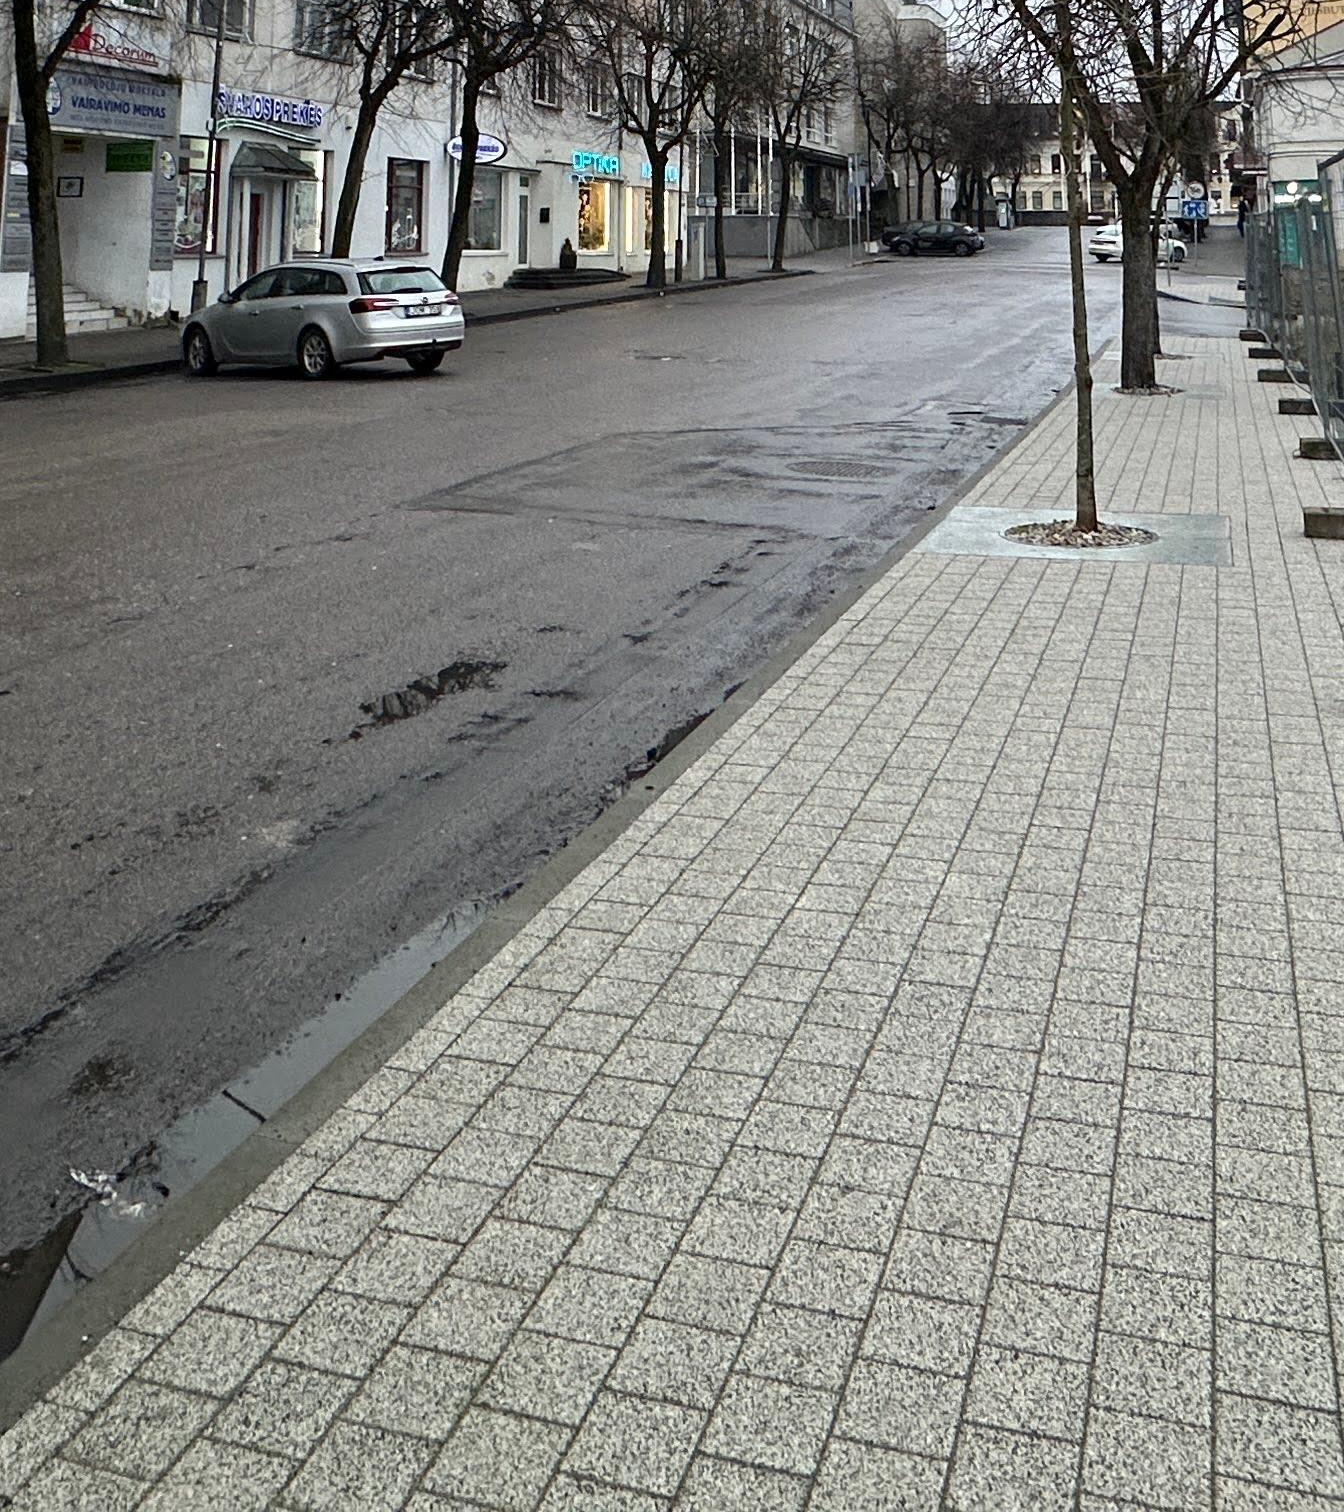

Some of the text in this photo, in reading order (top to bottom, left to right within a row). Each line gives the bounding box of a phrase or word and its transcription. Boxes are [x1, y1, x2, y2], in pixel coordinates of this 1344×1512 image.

[71, 95, 166, 119] VAIRAVIMO MENAS
[572, 149, 619, 176] OPTIKA
